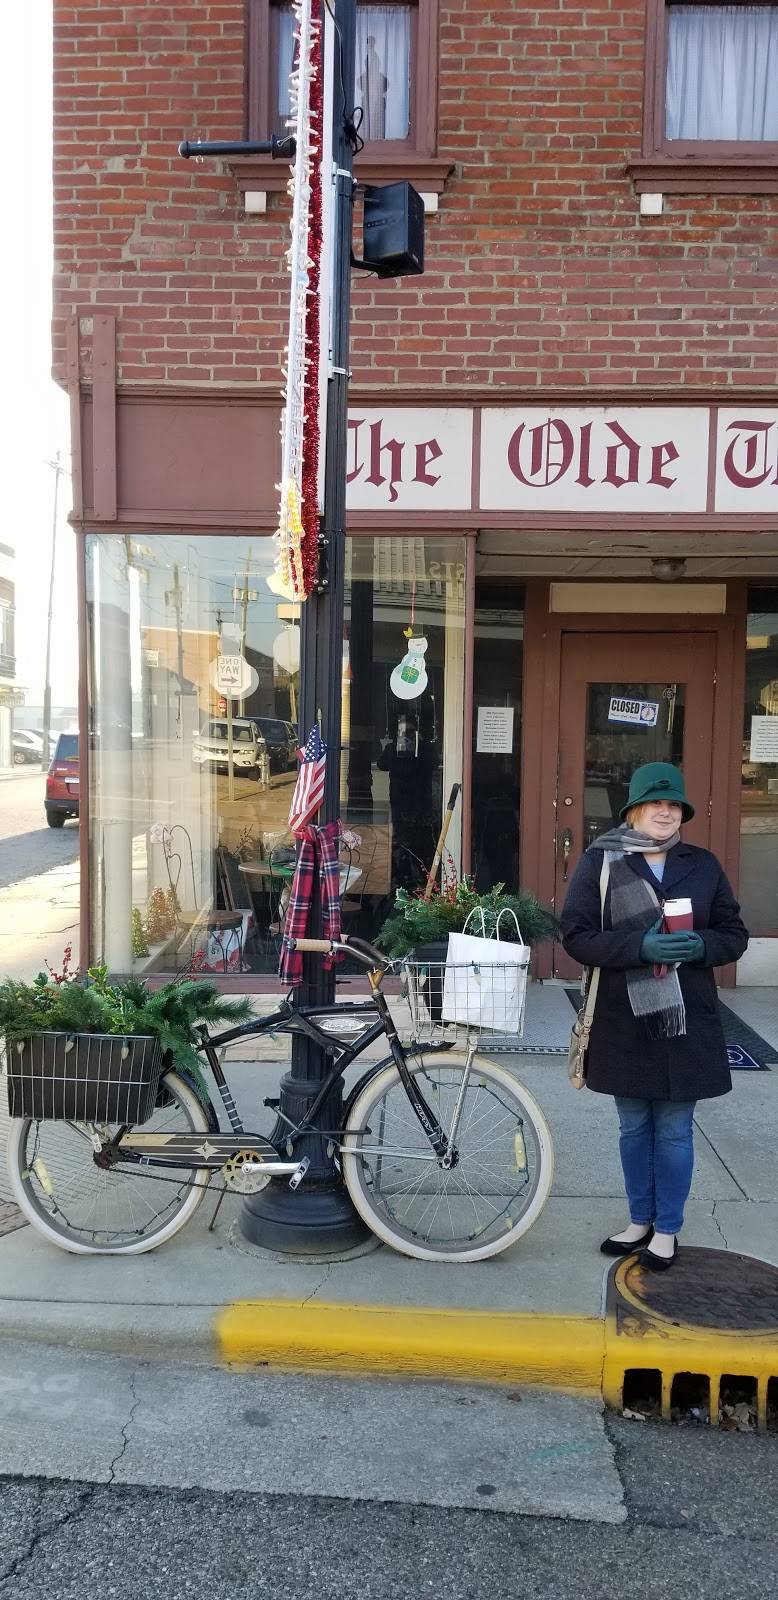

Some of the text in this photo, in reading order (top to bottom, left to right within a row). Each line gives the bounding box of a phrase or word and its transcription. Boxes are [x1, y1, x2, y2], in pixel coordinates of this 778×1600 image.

[508, 417, 680, 488] Olde
[724, 421, 778, 488] T
[611, 699, 640, 714] CLOSED
